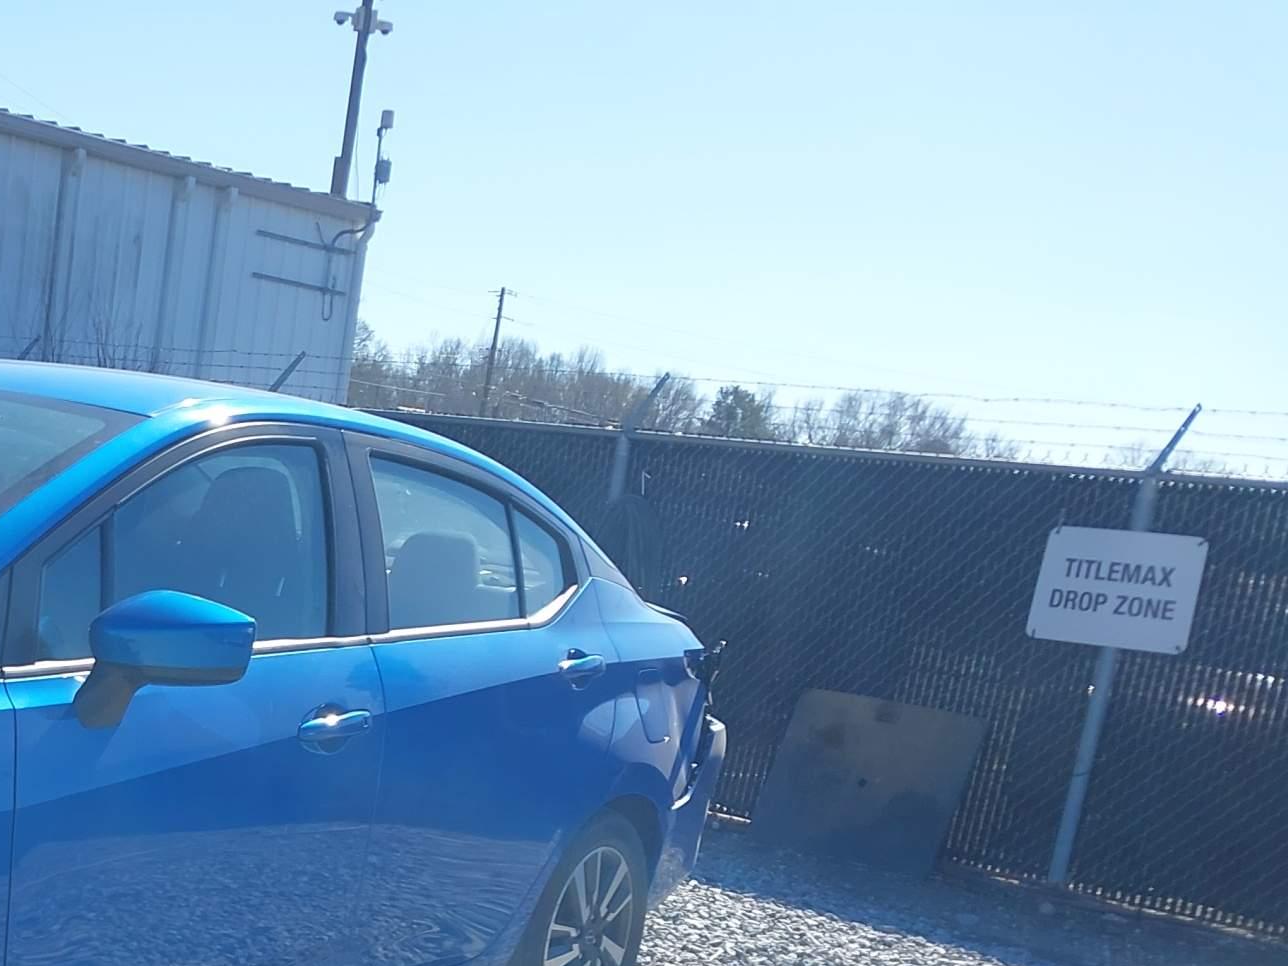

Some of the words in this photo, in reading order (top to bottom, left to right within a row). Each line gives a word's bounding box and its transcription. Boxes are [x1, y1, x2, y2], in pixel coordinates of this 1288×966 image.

[1065, 558, 1176, 587] TITLEMAX
[1049, 588, 1108, 612] DROP
[1113, 595, 1177, 621] ZONE
